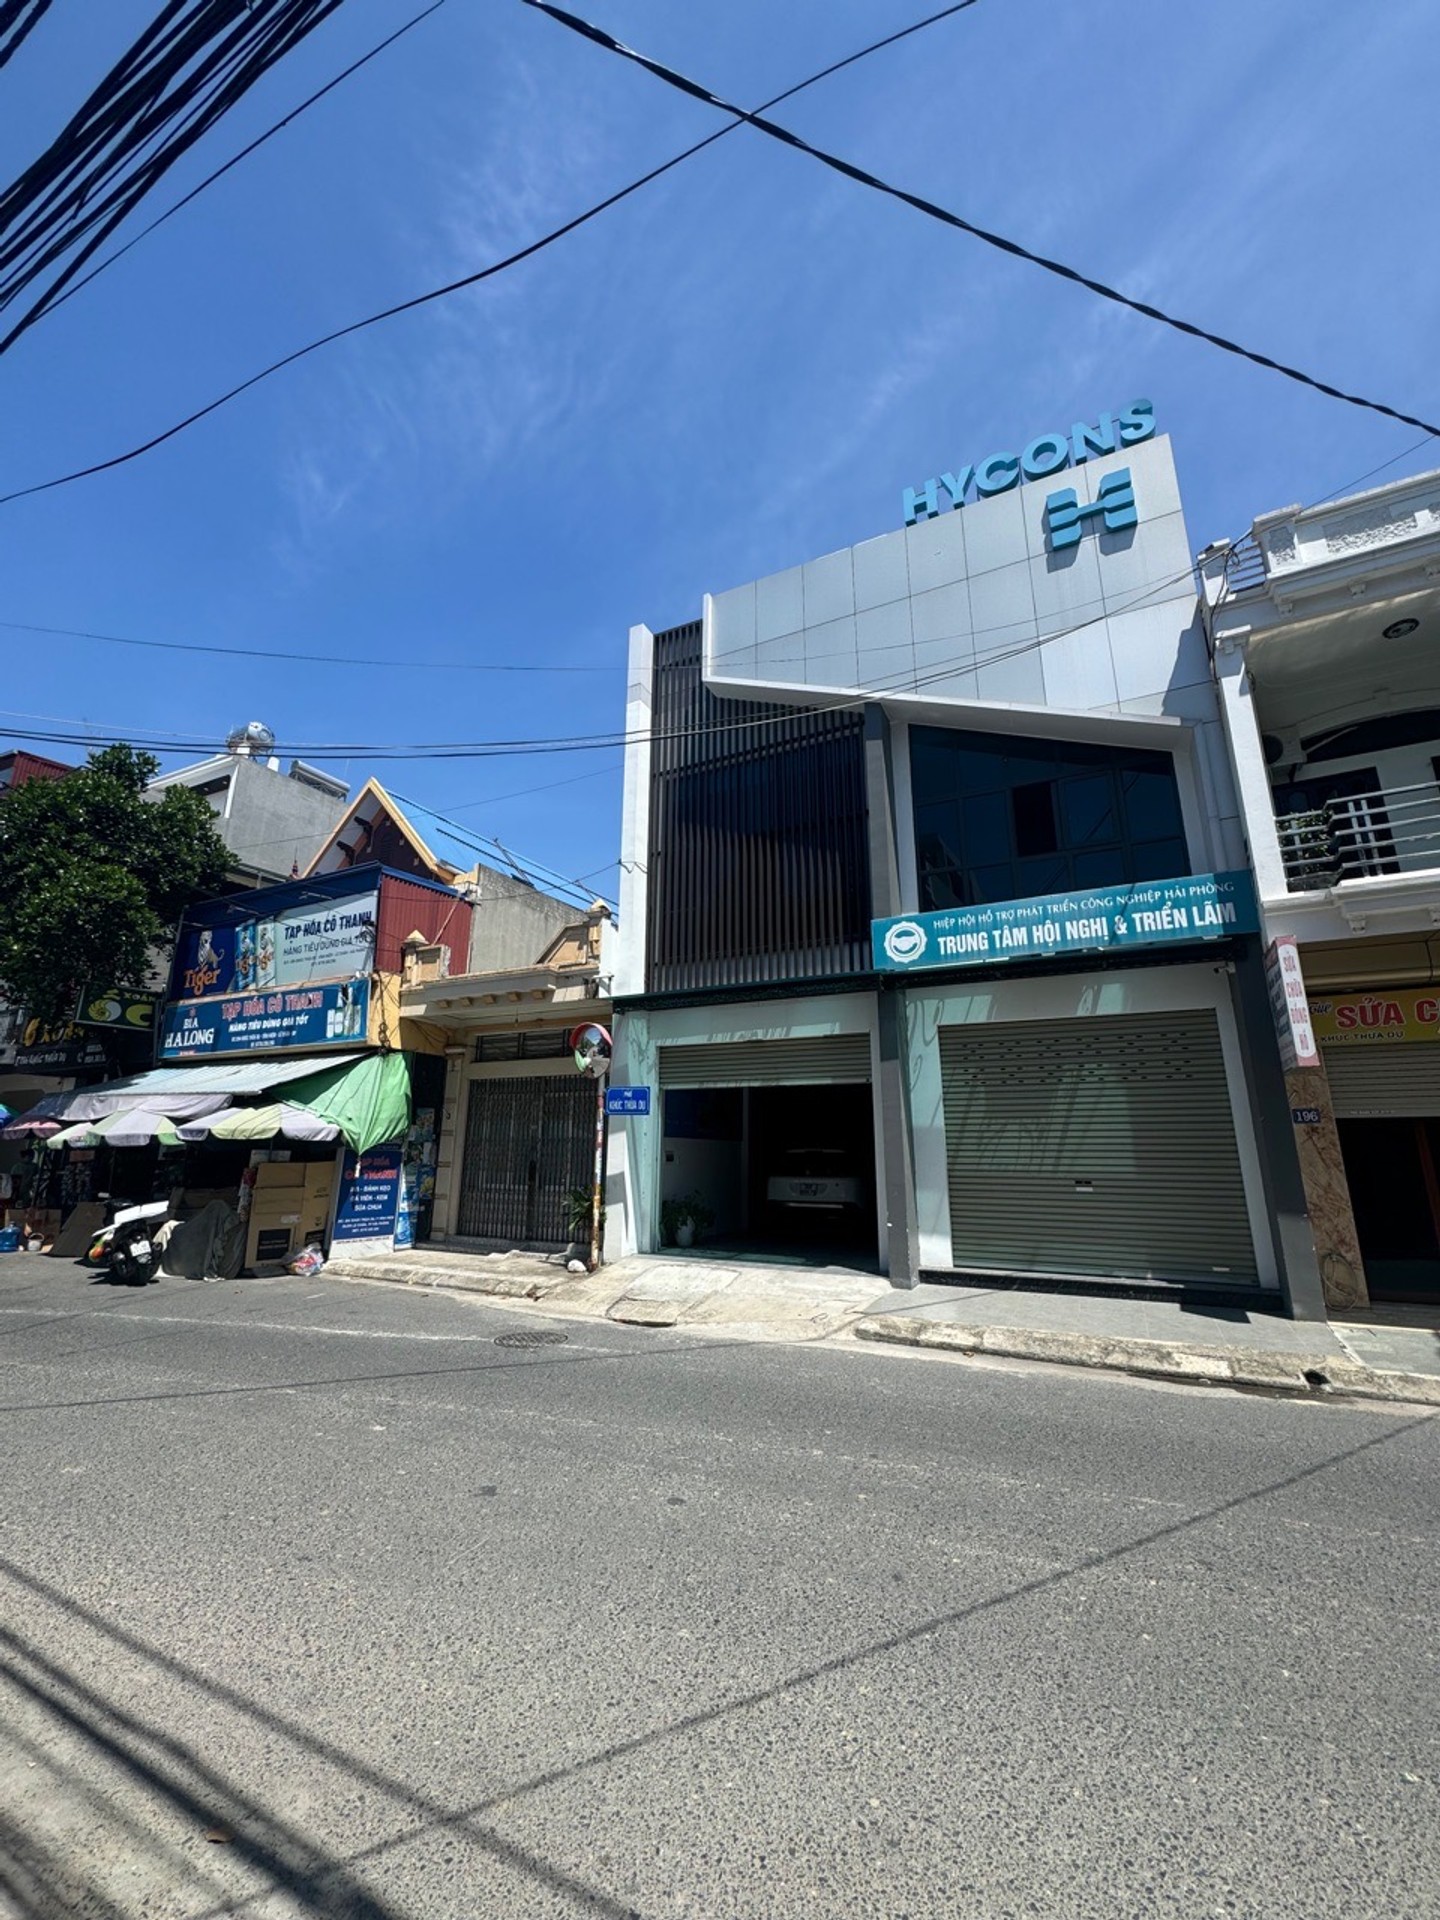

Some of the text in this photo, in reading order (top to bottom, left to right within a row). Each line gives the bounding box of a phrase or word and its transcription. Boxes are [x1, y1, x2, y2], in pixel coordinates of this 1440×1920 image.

[902, 398, 1156, 527] HYCONS
[933, 917, 955, 929] HIỆP
[958, 914, 975, 927] HỘI
[995, 908, 1015, 921] TRỢ
[1080, 896, 1113, 909] CÔNG
[1116, 890, 1161, 905] NGHIỆP
[1164, 885, 1187, 900] HẢI
[1189, 881, 1235, 897] PHÒNG
[323, 914, 336, 932] CÔ
[937, 899, 1237, 955] TRUNG TÂM HỘI NGHỊ & TRIỂN LÃM
[184, 965, 221, 996] Tiger
[267, 993, 282, 1013] CÔ
[1336, 997, 1440, 1029] SỬA C
[183, 1018, 199, 1029] BIA
[1296, 1111, 1319, 1122] 196
